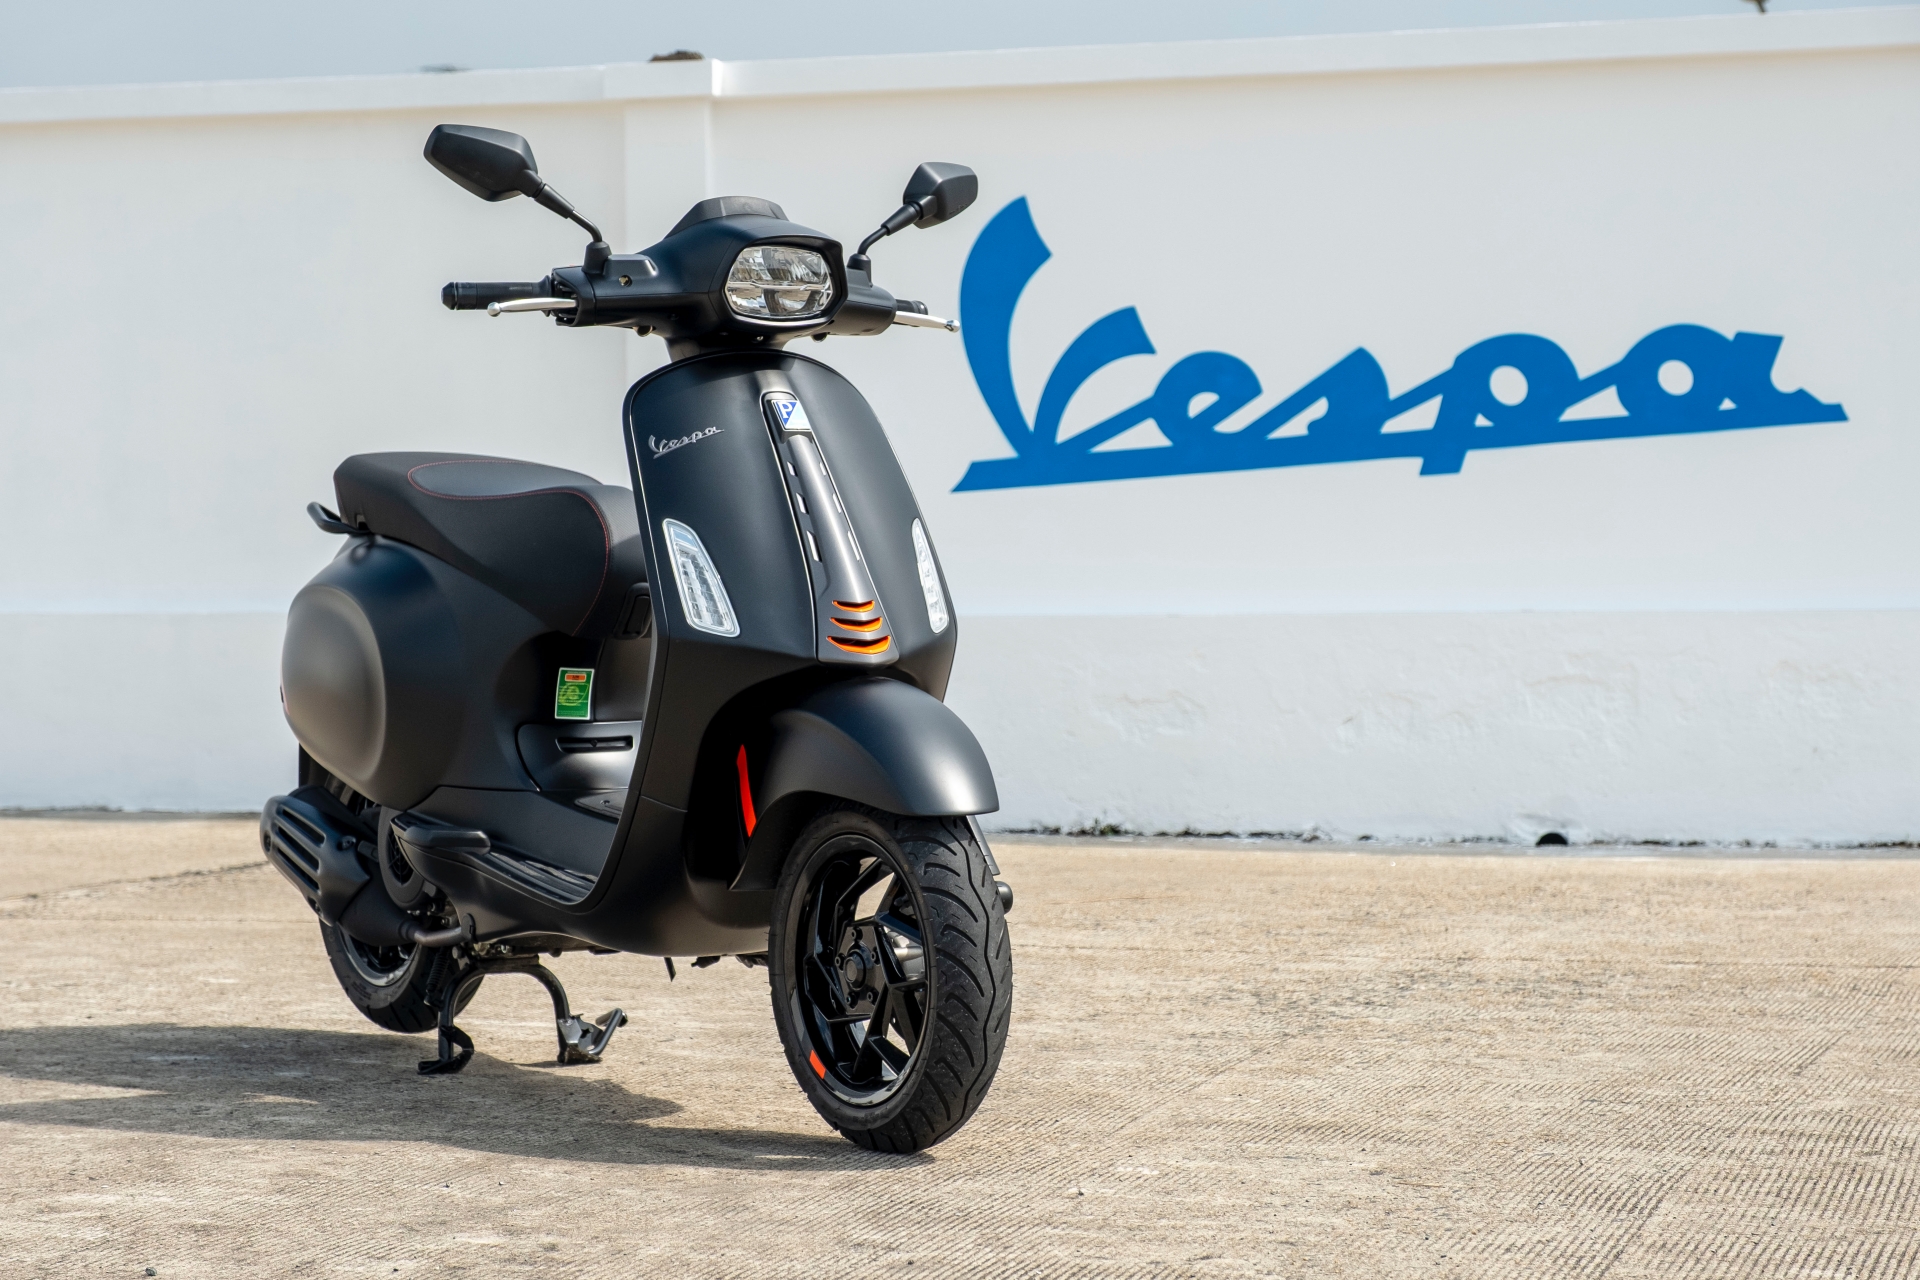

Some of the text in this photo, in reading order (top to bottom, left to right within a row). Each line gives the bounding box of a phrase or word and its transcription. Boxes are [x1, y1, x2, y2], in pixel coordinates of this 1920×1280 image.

[952, 196, 1848, 493] Vespa
[778, 401, 793, 418] P
[648, 426, 725, 459] Vespa
